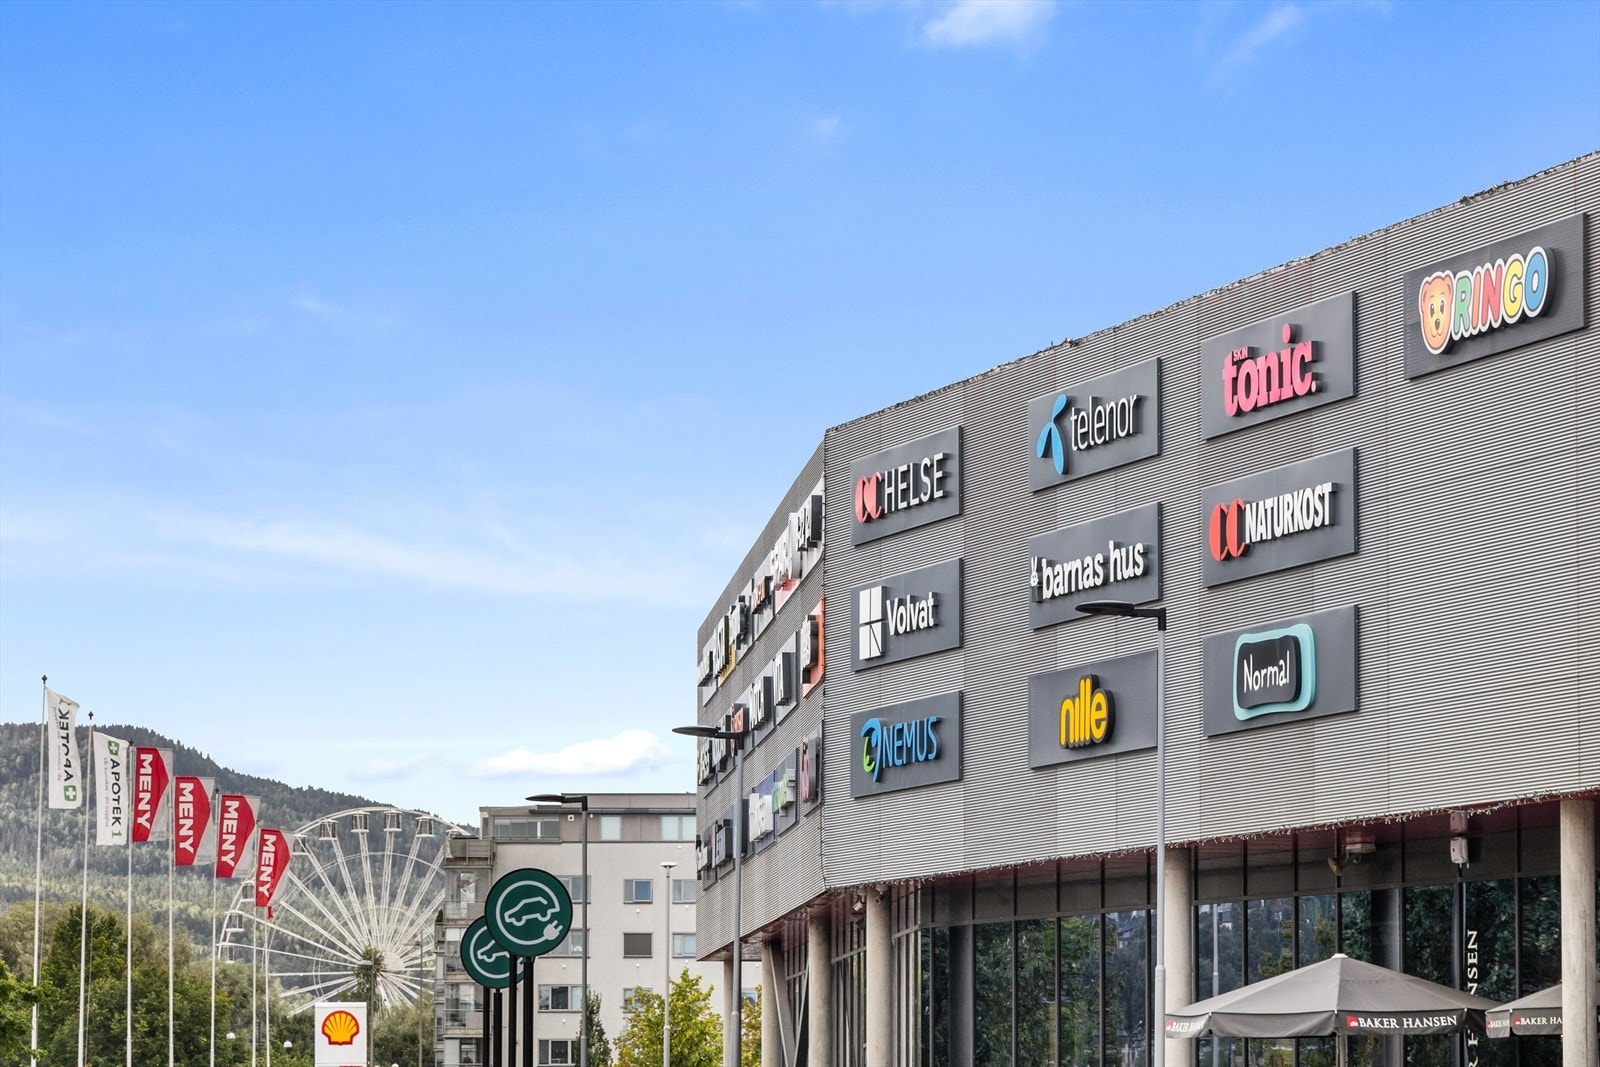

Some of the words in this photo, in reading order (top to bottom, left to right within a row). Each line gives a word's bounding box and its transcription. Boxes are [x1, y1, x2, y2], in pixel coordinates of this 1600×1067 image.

[1452, 248, 1549, 339] RINGO
[1070, 394, 1137, 451] telenor
[884, 452, 944, 514] HELSE
[1245, 482, 1332, 545] NATURKOST
[1041, 553, 1104, 600] barnas
[1108, 540, 1144, 583] hus
[886, 591, 935, 636] Volvat
[1243, 650, 1290, 694] Normal
[882, 716, 938, 768] NEMUS
[1059, 675, 1108, 747] nille
[110, 758, 122, 827] APOTEK
[137, 754, 153, 830] MENY
[179, 782, 194, 854] MENY
[111, 830, 122, 839] 1
[221, 800, 240, 867] MENY
[258, 834, 277, 898] MENY
[1358, 1017, 1400, 1029] BAKER
[1403, 1015, 1458, 1028] HANSEN
[1520, 1017, 1548, 1026] BAKER
